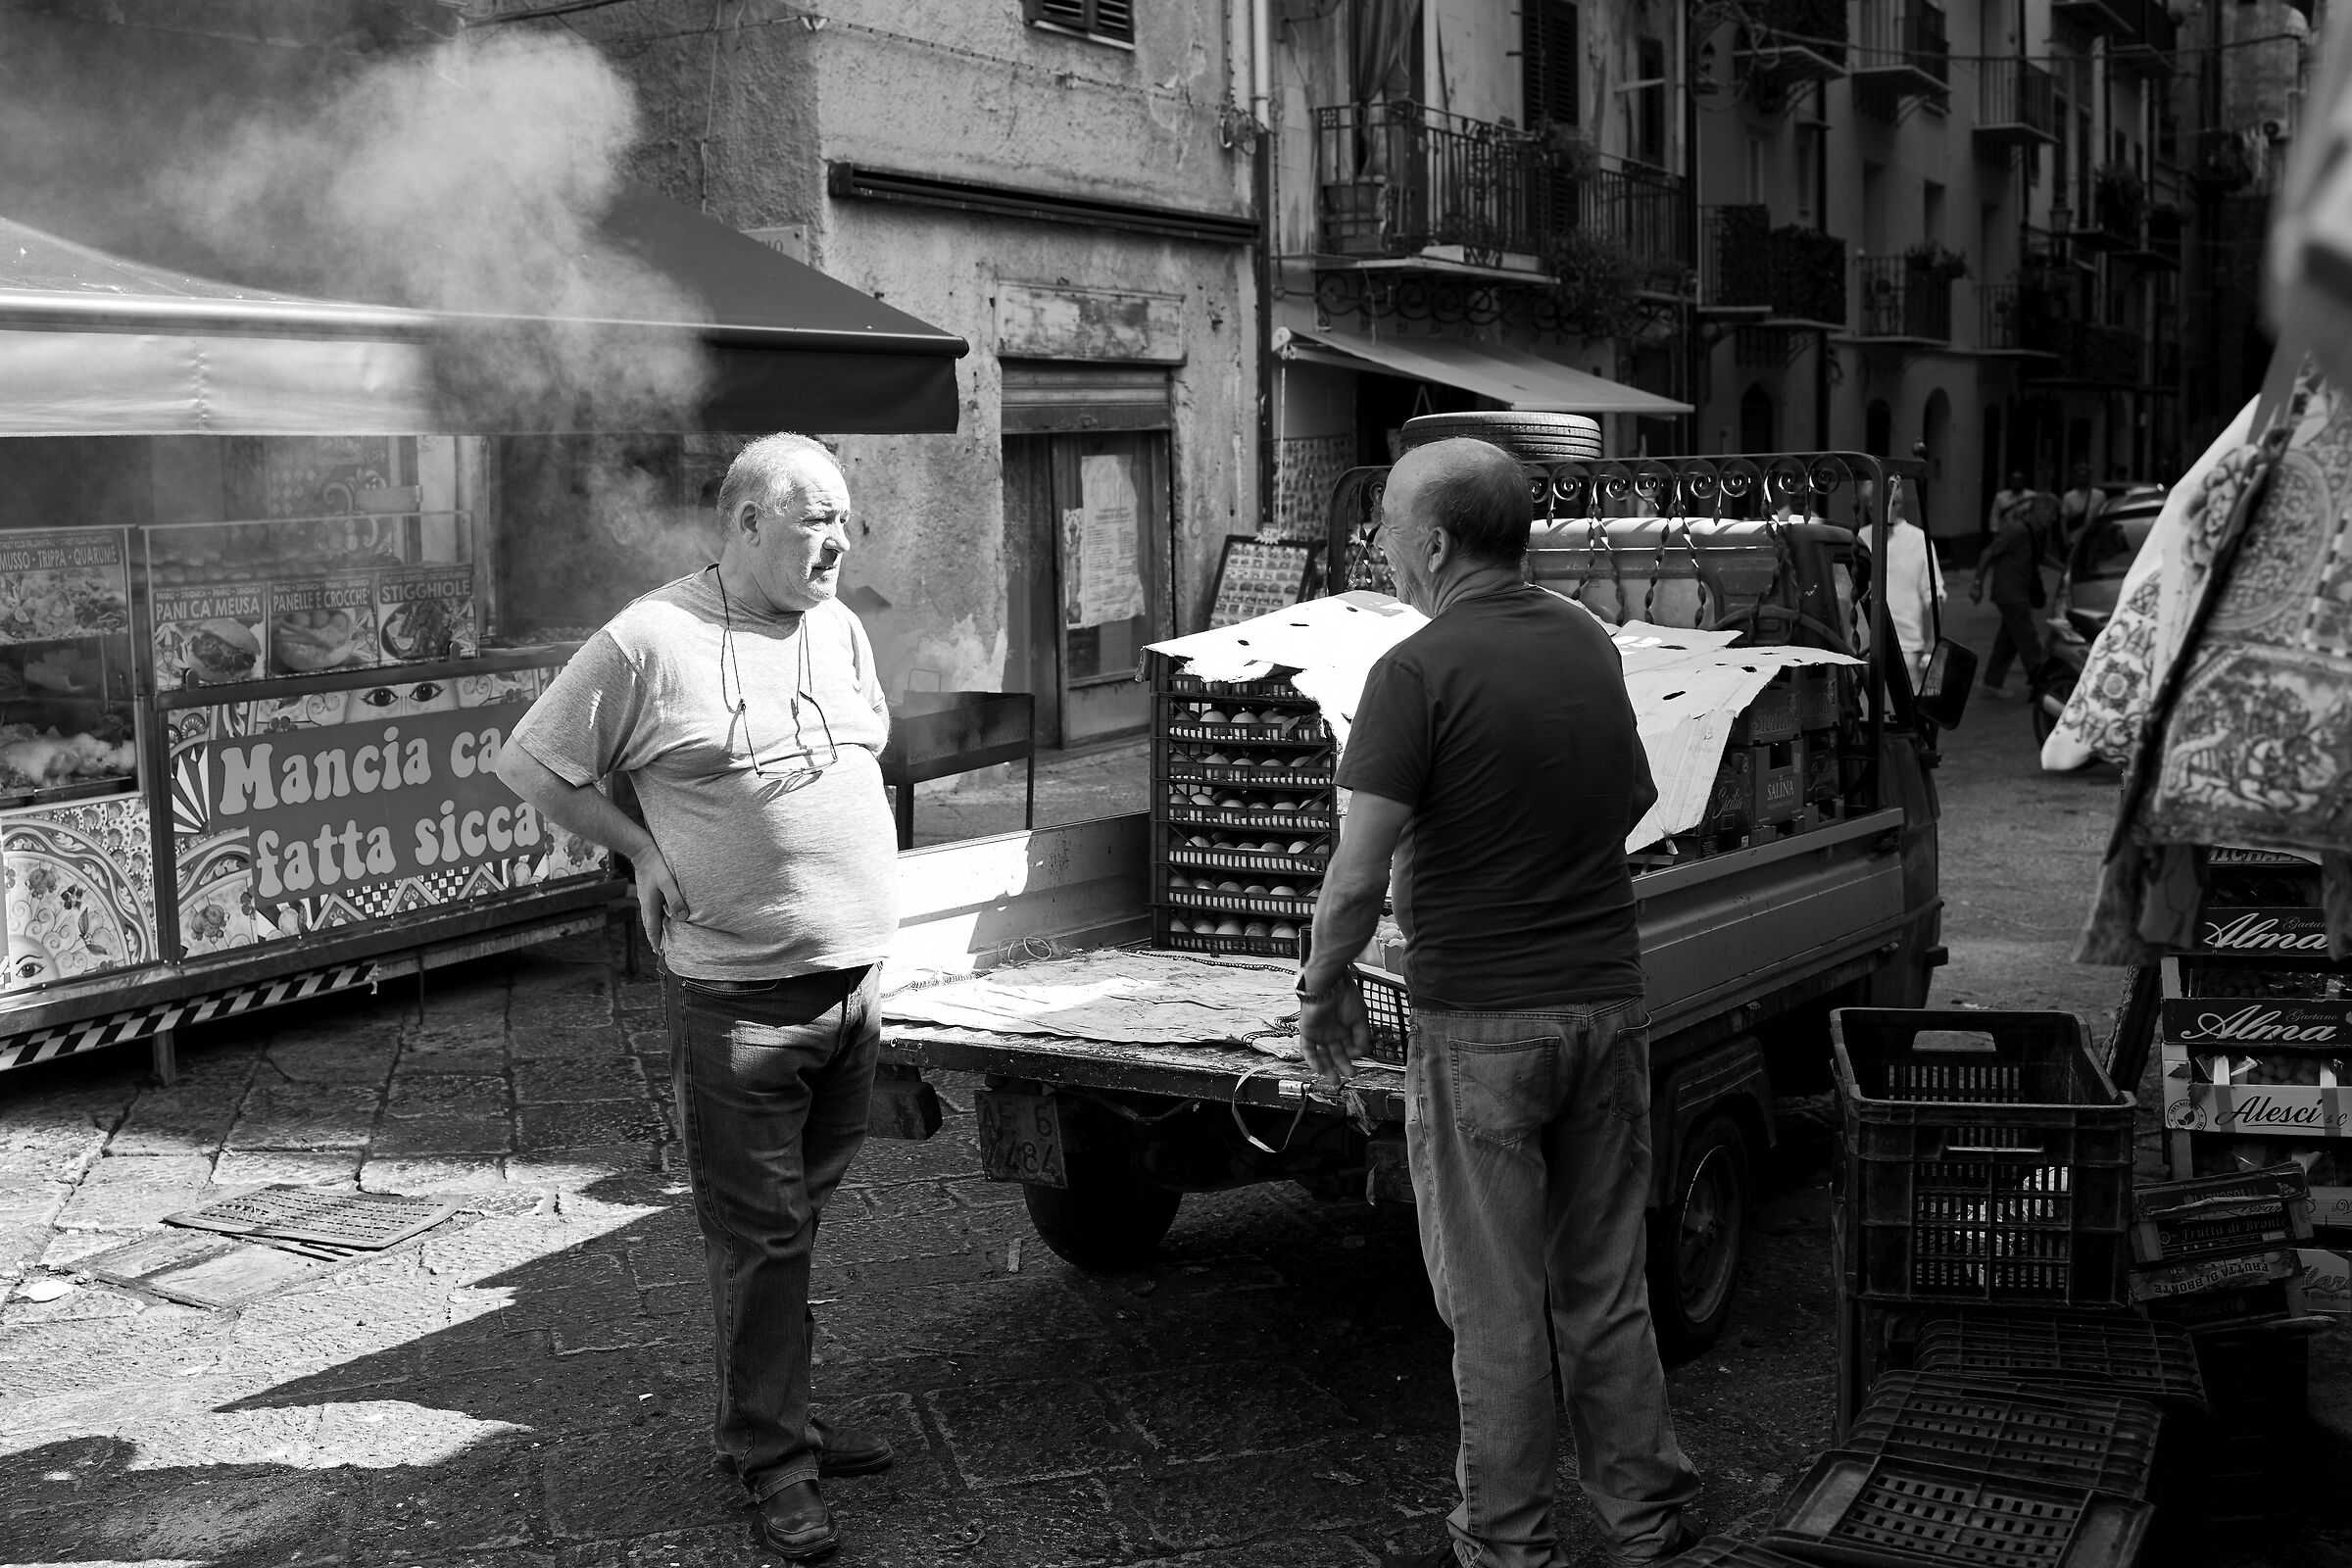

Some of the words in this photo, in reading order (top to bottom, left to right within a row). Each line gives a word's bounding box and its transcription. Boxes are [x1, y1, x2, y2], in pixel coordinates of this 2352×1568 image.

[0, 551, 29, 570] MUSSO
[37, 549, 67, 568] TRIPPA
[74, 545, 118, 565] QUARUME
[273, 591, 314, 612] PANELLE
[316, 591, 322, 609] E
[382, 579, 471, 603] STIGGHIOLE
[156, 601, 187, 621] PANI
[215, 596, 261, 616] MEUSA
[219, 726, 431, 815] Mancia
[1767, 778, 1794, 801] SALINA
[256, 819, 397, 898] fatta
[415, 799, 541, 866] sicca
[2203, 912, 2329, 950] Alma
[2180, 1004, 2338, 1042] Alma
[2285, 1008, 2338, 1023] Gaetano
[1034, 1103, 1053, 1137] 6
[2215, 1096, 2324, 1126] Alesci
[2180, 1225, 2225, 1242] Frutta
[2229, 1221, 2241, 1234] di
[2221, 1261, 2270, 1278] FRUTTA
[2153, 1278, 2204, 1294] BRONTE
